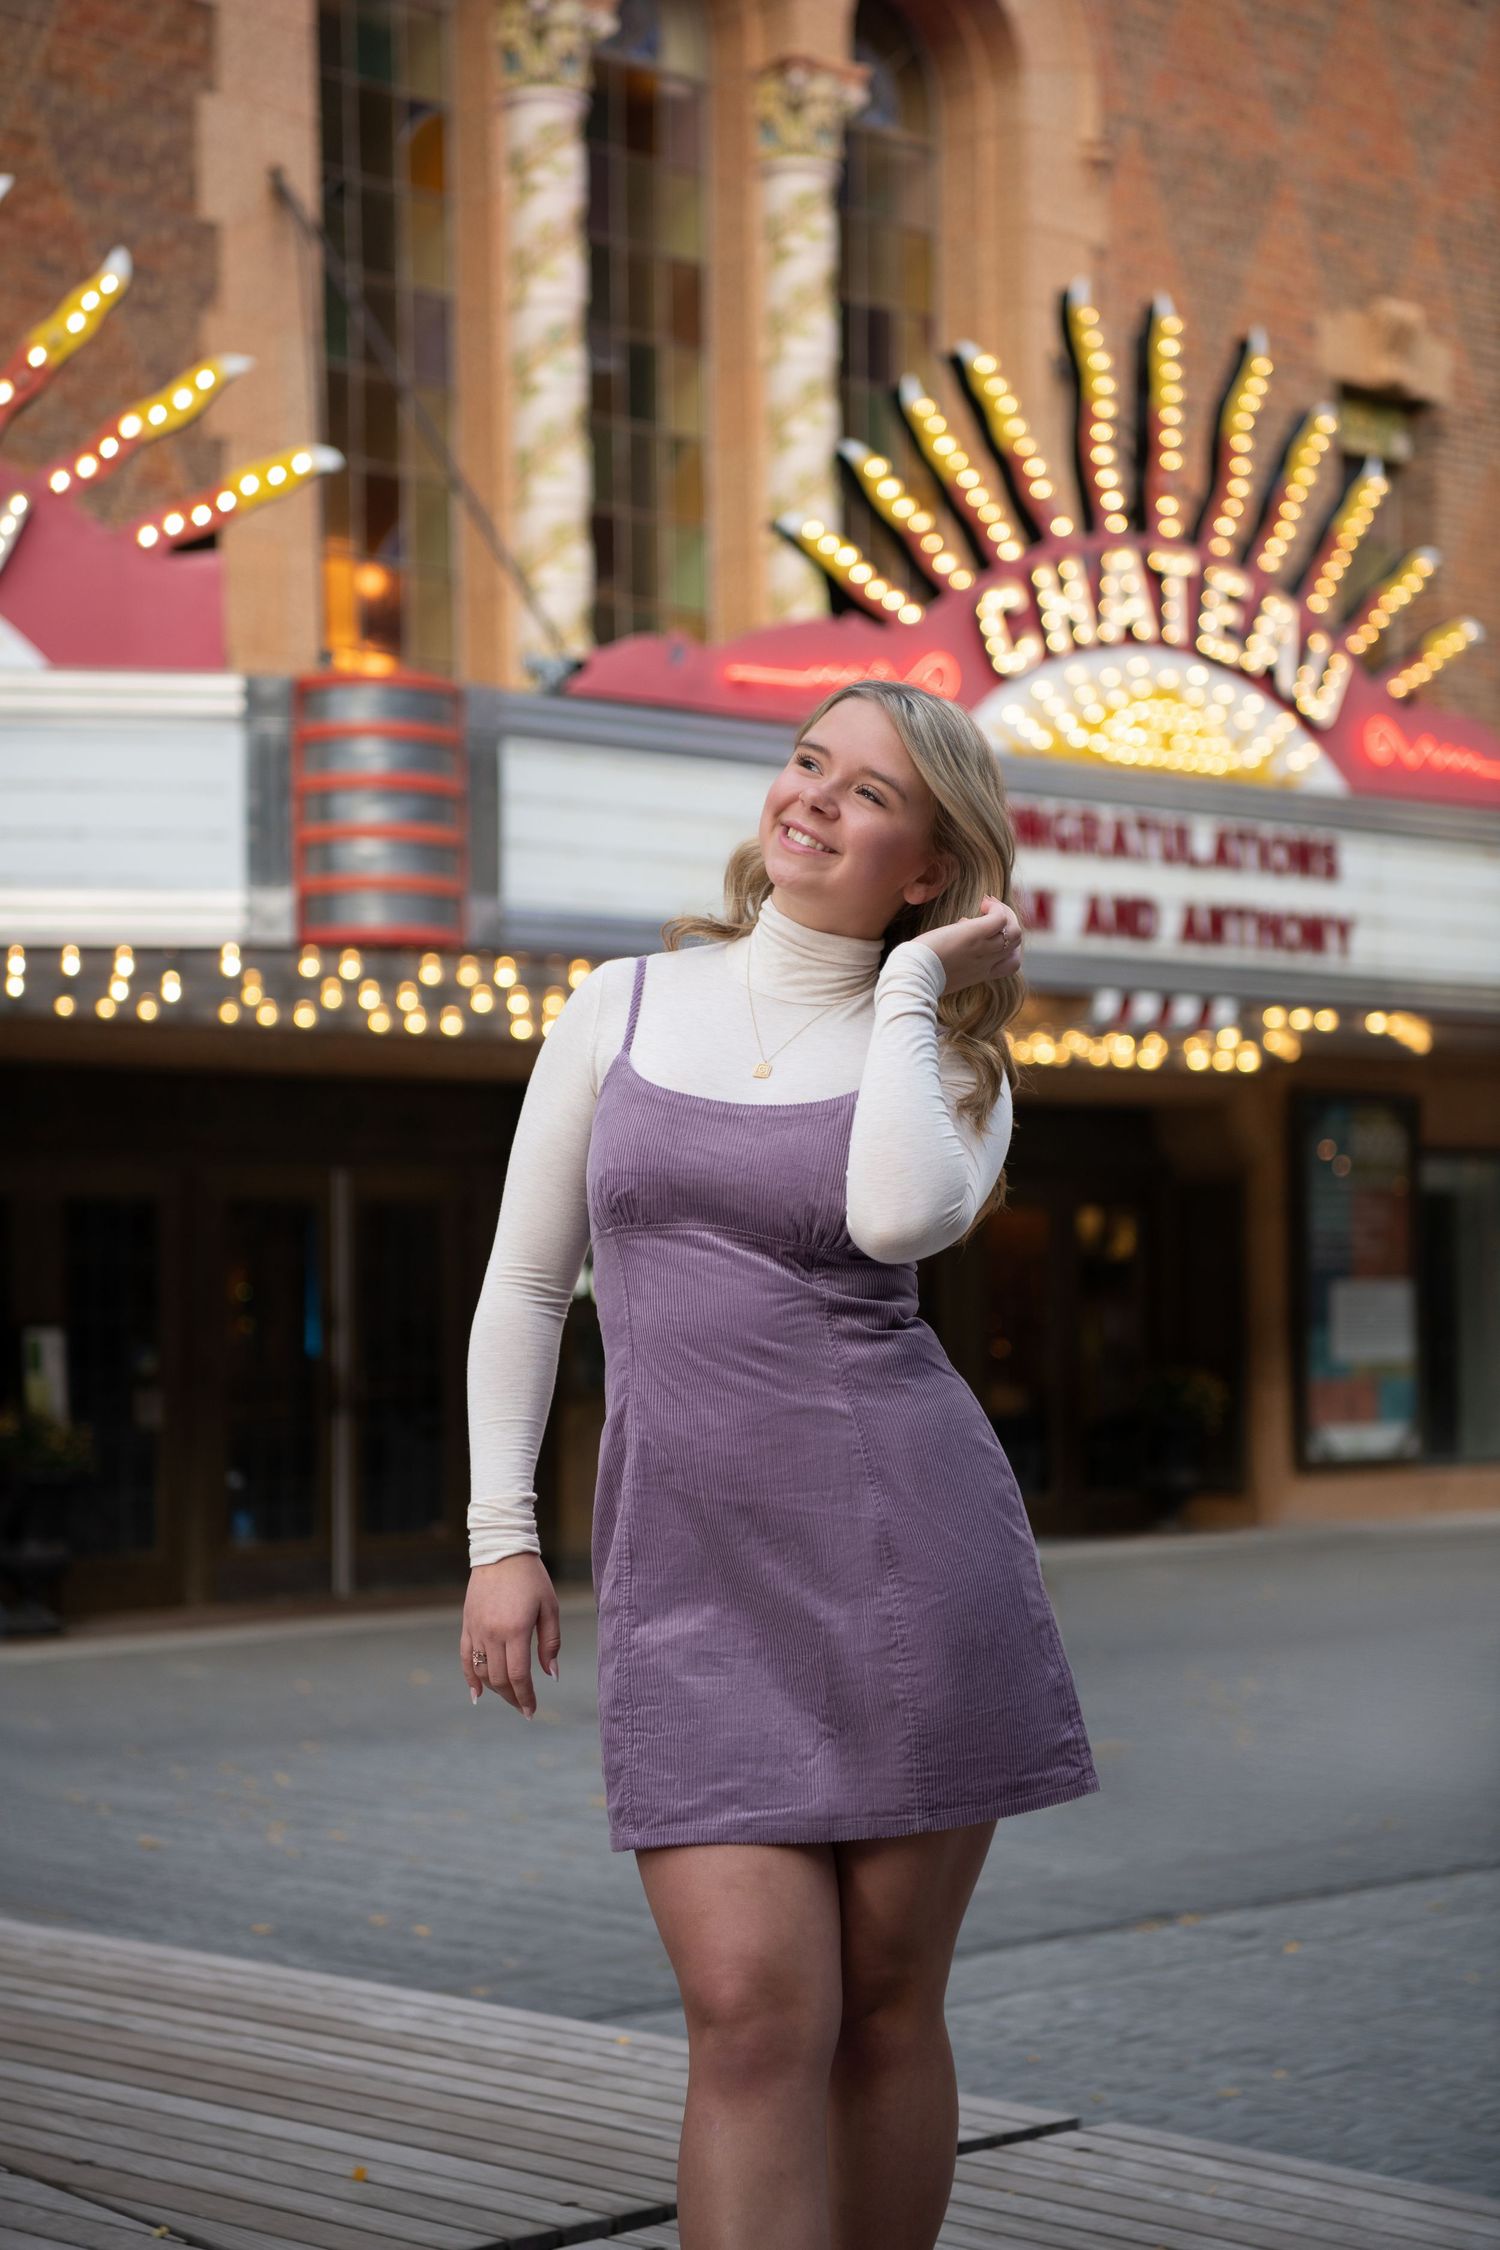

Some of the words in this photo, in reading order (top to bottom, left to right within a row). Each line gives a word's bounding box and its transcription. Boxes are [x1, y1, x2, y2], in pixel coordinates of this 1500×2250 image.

[976, 548, 1352, 728] CHATEAU
[1084, 895, 1158, 940] AND
[1182, 904, 1355, 957] ANTHONY
